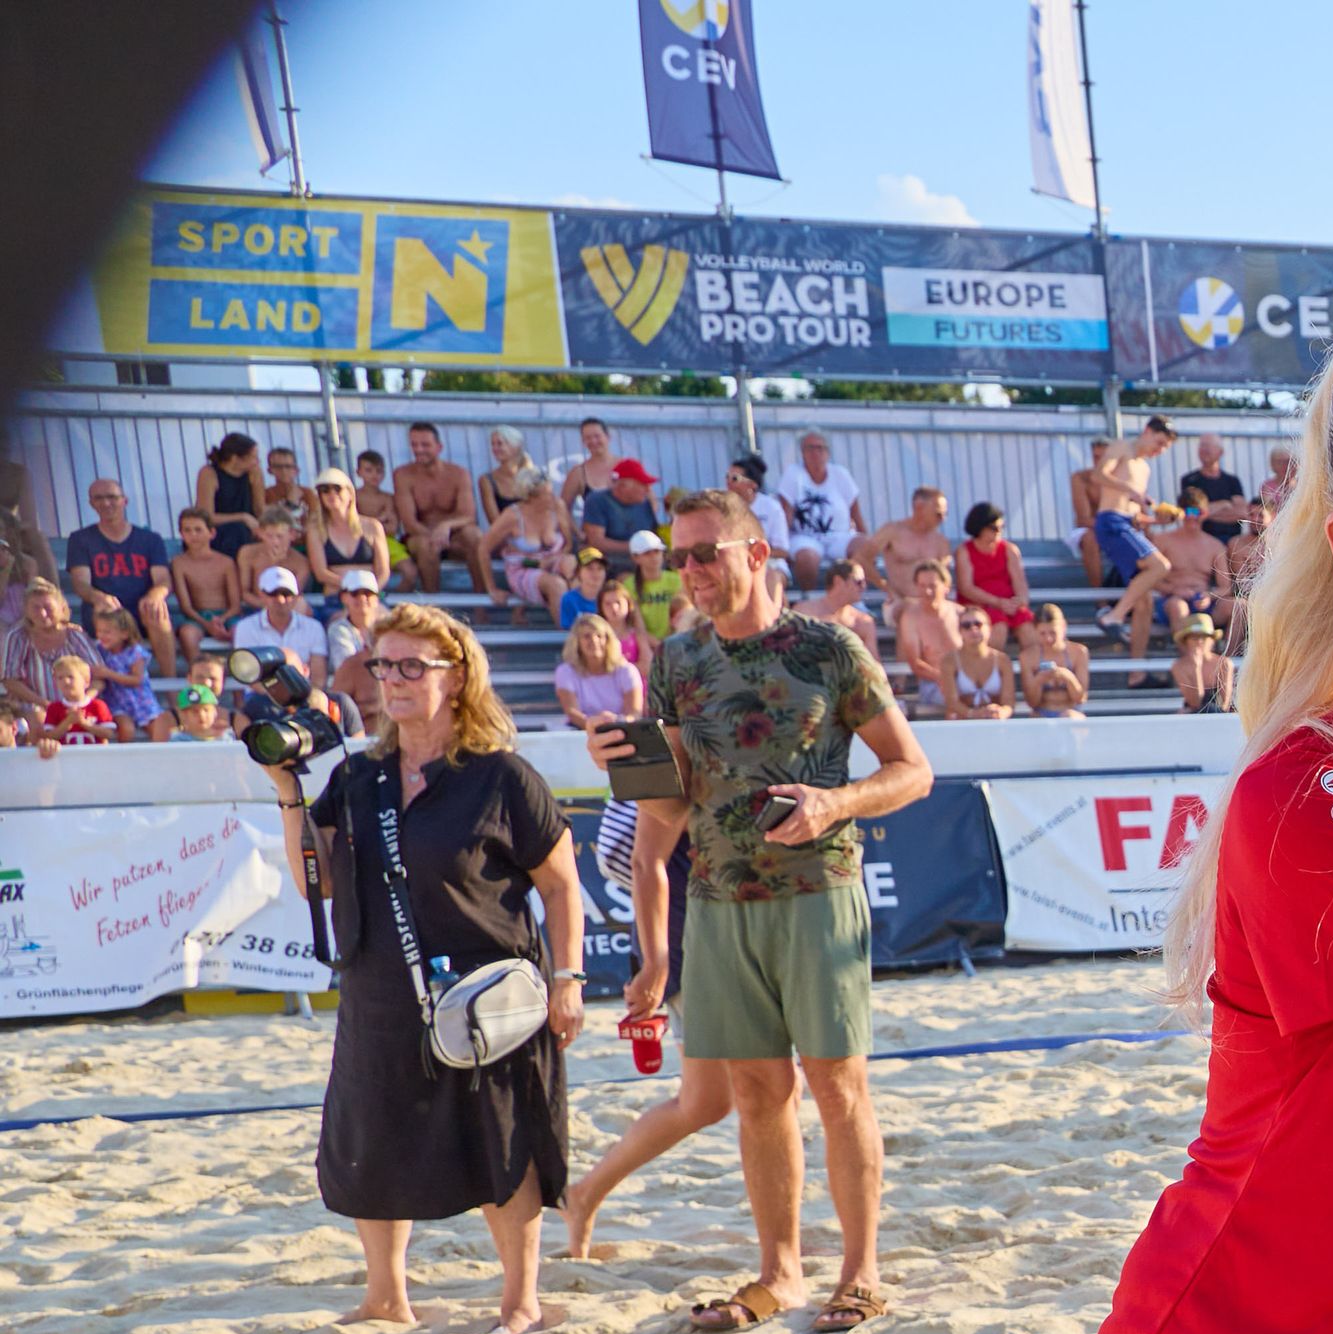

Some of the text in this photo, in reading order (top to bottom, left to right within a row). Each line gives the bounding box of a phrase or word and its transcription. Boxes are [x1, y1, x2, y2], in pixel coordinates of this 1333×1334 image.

[662, 44, 736, 90] CEV
[177, 221, 339, 258] SPORT
[695, 254, 866, 275] VOLLEYBALL WORLD
[694, 270, 870, 317] BEACH
[924, 279, 1066, 309] EUROPE
[189, 298, 322, 333] LAND
[700, 313, 871, 347] PRO TOUR
[934, 320, 1063, 343] FUTURES
[93, 553, 148, 578] GAP
[69, 877, 103, 911] Wir
[179, 836, 215, 861] dass
[221, 817, 241, 841] die
[96, 916, 152, 947] Fetzen
[241, 934, 275, 954] 38
